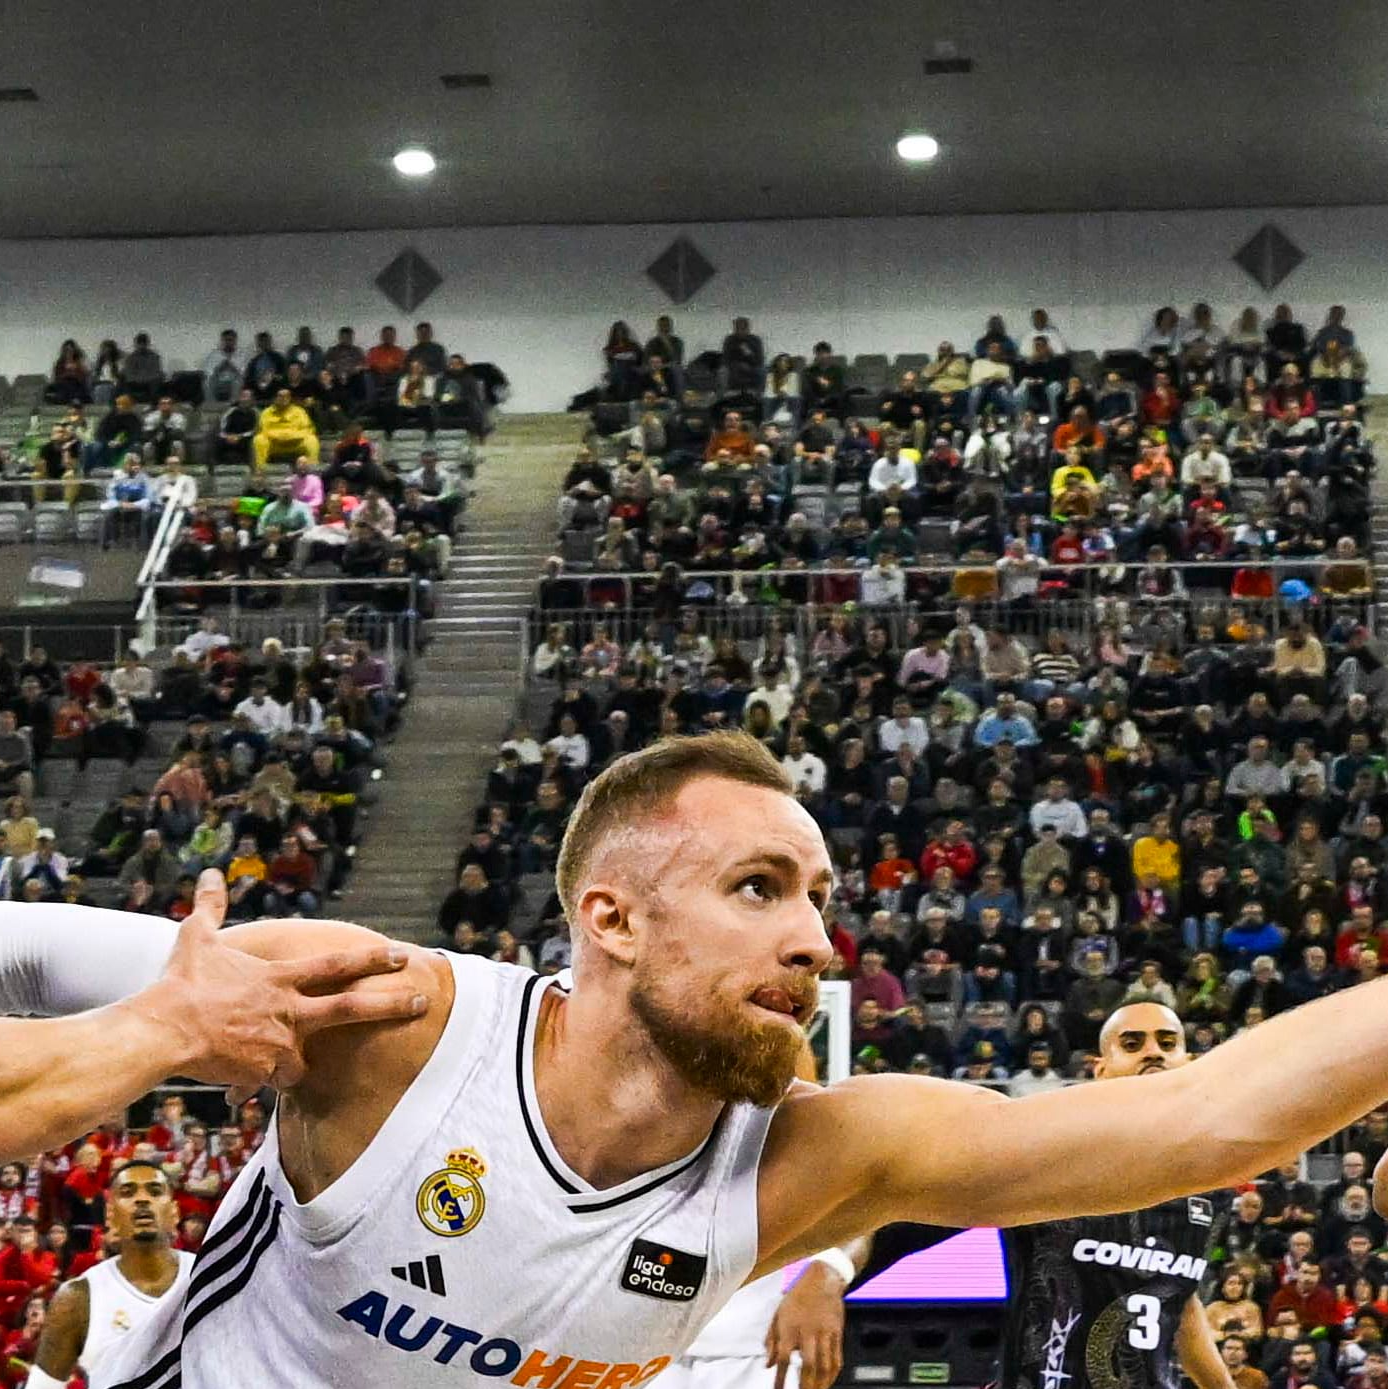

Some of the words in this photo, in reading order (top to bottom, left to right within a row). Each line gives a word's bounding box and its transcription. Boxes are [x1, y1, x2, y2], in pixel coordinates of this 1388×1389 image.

[633, 1255, 666, 1277] liga
[629, 1273, 695, 1297] endesa
[1127, 1294, 1161, 1350] 3
